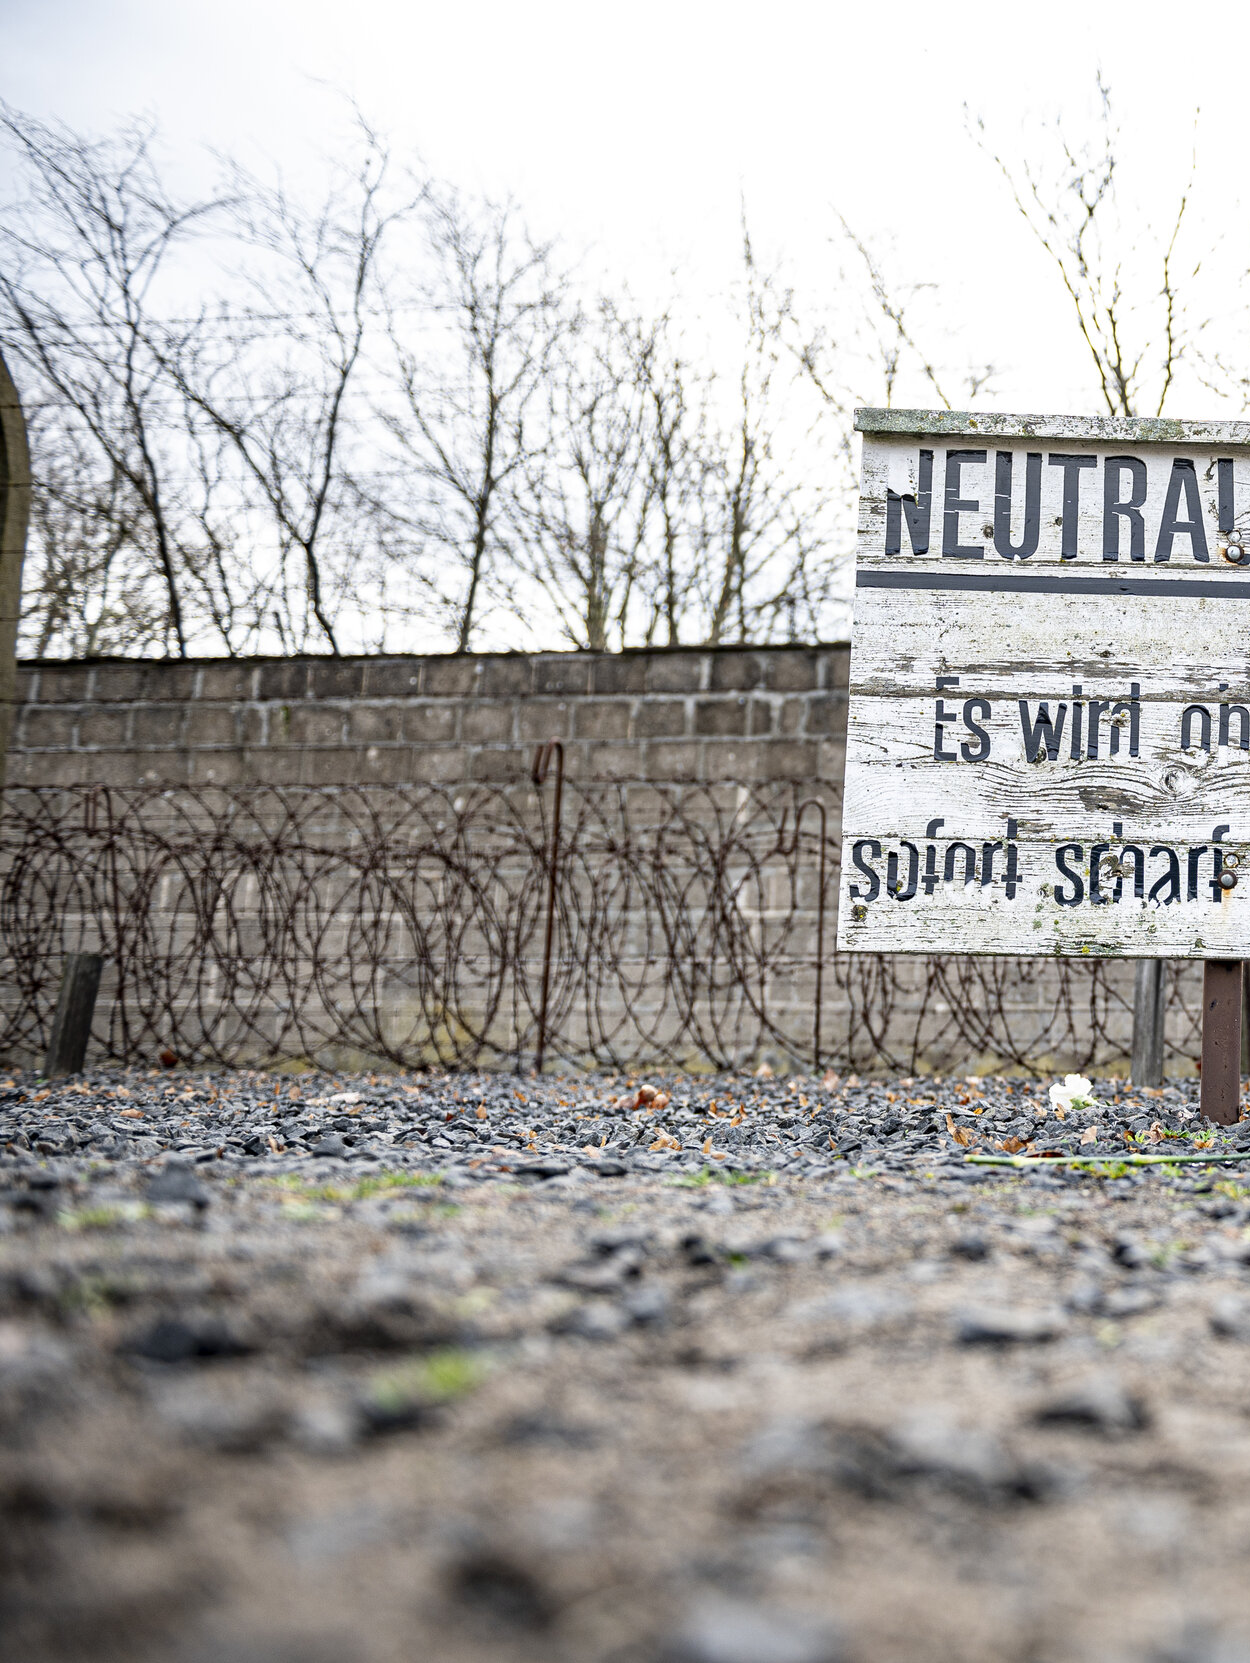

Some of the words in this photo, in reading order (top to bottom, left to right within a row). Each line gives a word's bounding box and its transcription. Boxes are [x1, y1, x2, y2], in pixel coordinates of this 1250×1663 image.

[934, 676, 992, 762] Es
[1019, 682, 1141, 763] wird
[849, 818, 1023, 901] sofort
[1054, 822, 1230, 907] scharf
